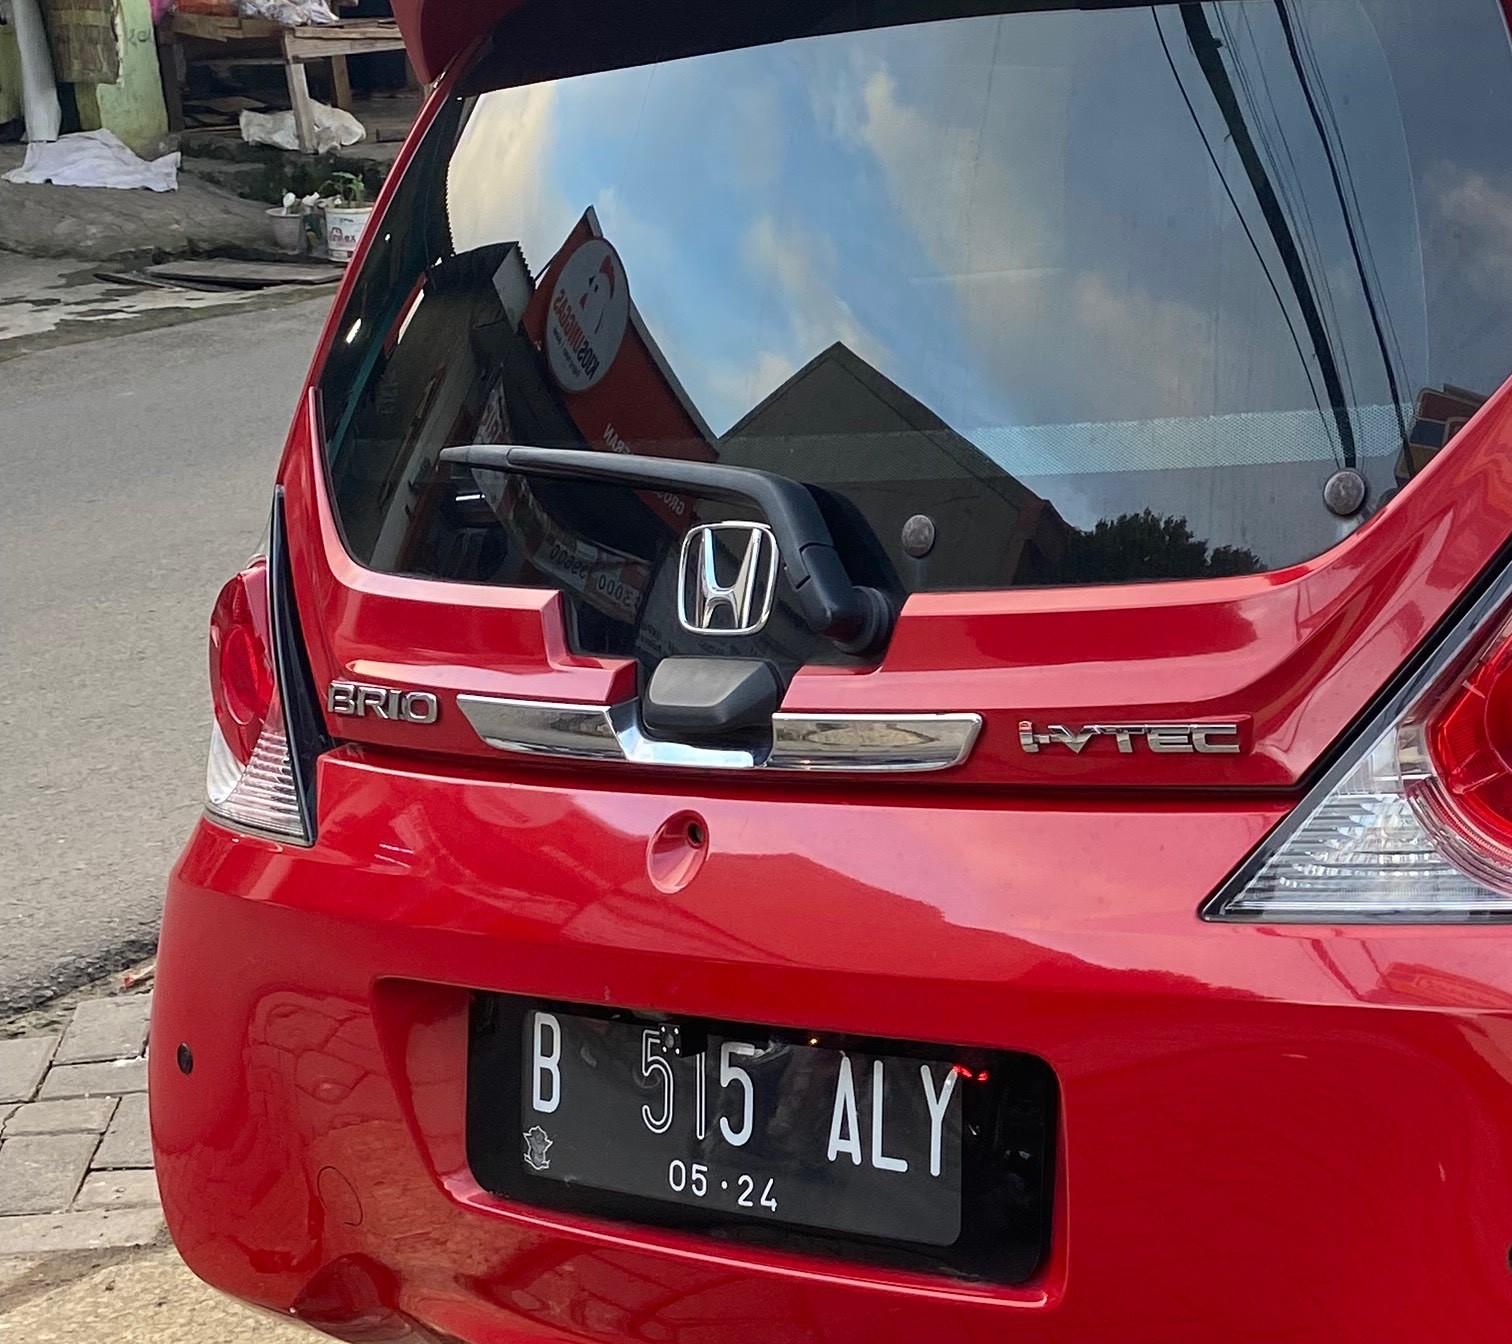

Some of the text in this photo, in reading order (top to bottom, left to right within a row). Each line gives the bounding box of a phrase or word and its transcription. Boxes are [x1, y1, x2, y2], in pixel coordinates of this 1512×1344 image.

[327, 682, 438, 724] BRIO
[531, 1011, 958, 1178] B 515 ALY
